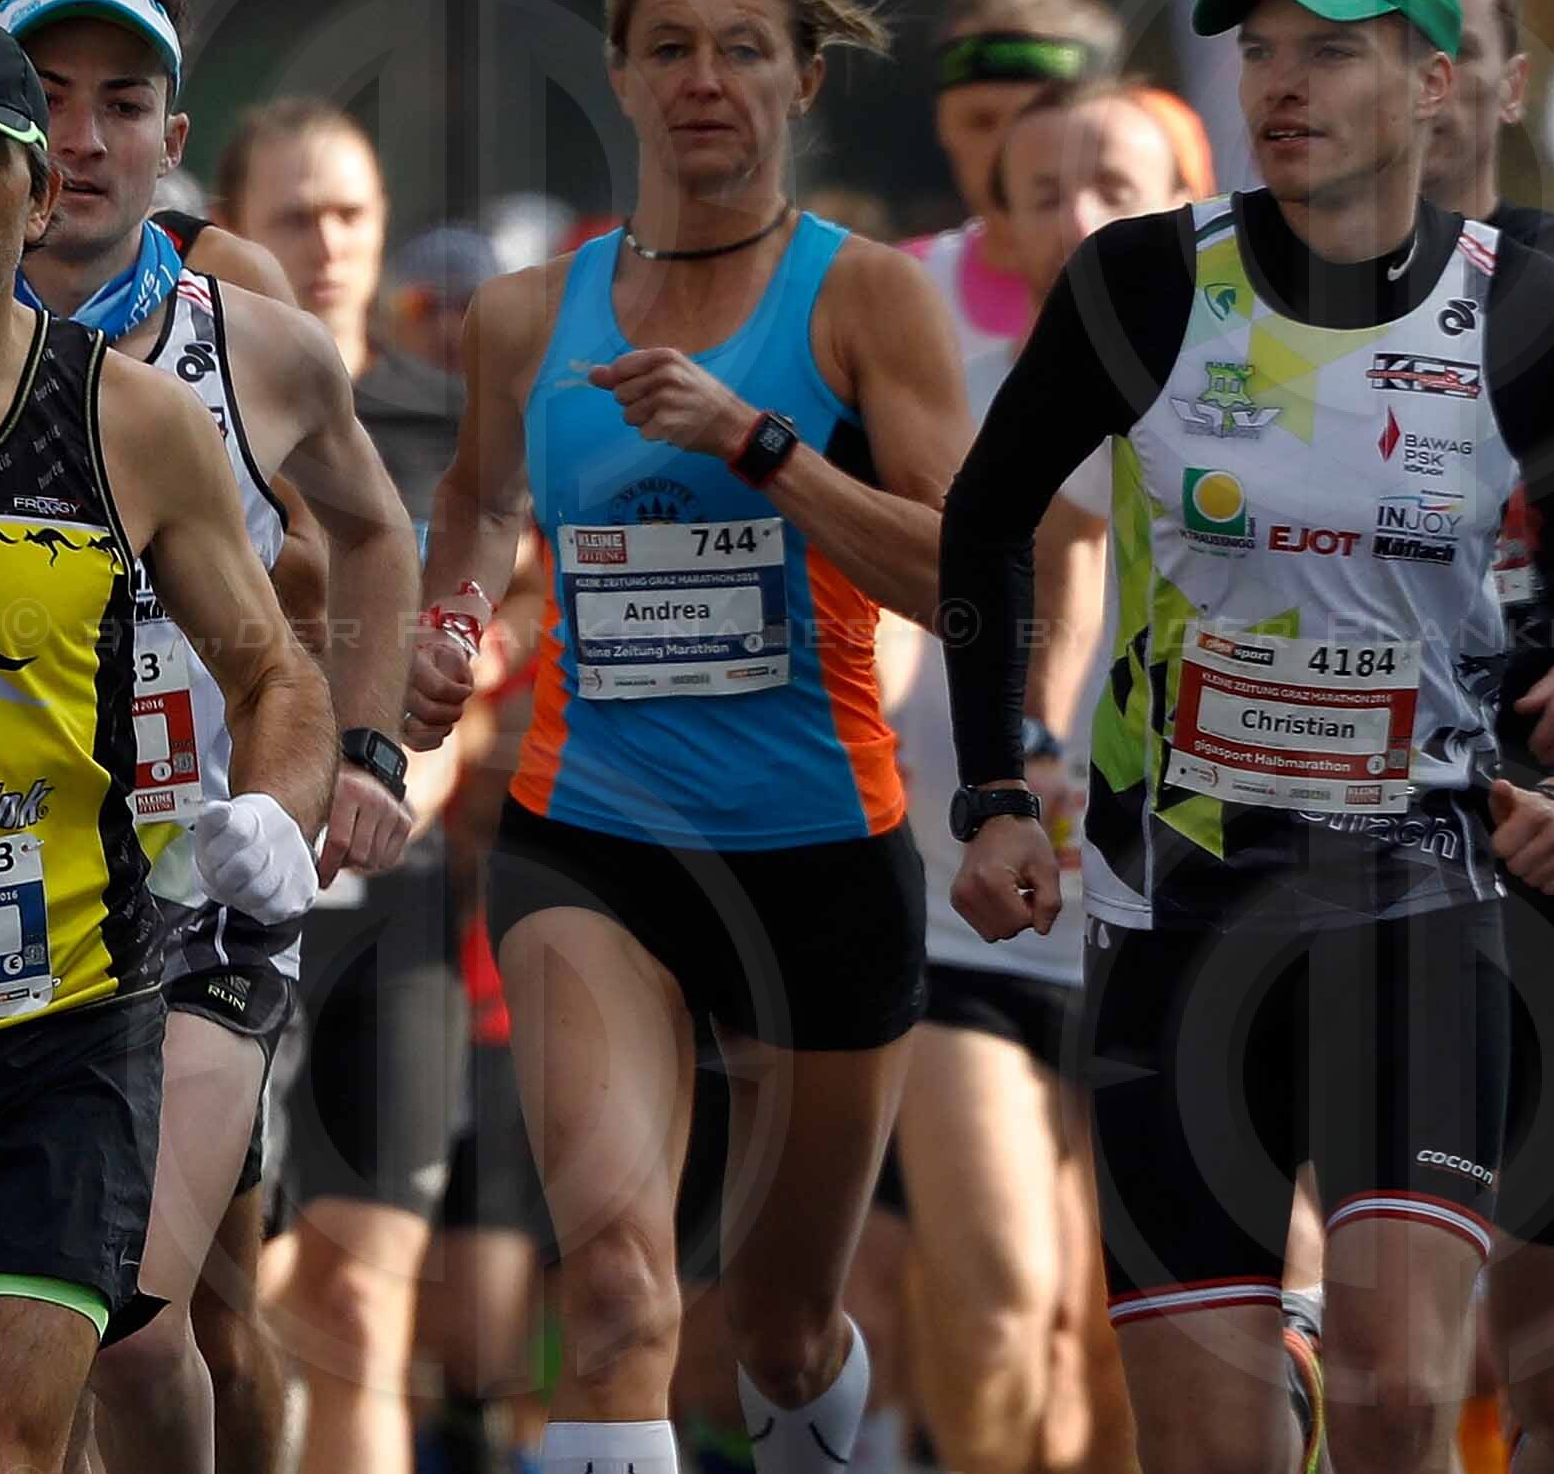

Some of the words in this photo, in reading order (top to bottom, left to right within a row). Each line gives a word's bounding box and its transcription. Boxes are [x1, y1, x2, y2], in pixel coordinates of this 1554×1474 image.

[1404, 434, 1473, 455] BAWAG
[1404, 450, 1445, 466] PSK
[13, 496, 81, 516] FROGGY
[1377, 506, 1464, 535] INJOY
[690, 526, 758, 557] 744
[1268, 525, 1363, 557] EJOT
[623, 601, 711, 622] Andrea
[613, 644, 664, 660] Zeitung
[666, 642, 730, 658] Marathon
[1234, 646, 1274, 664] sport
[1308, 646, 1396, 678] 4184
[1234, 678, 1280, 697] ZEITUNG
[1241, 709, 1356, 739] Christian
[1194, 739, 1253, 765] gigasport
[1254, 752, 1352, 773] Halbmarathon
[207, 983, 247, 1013] RUN
[1416, 1149, 1494, 1184] cocoon
